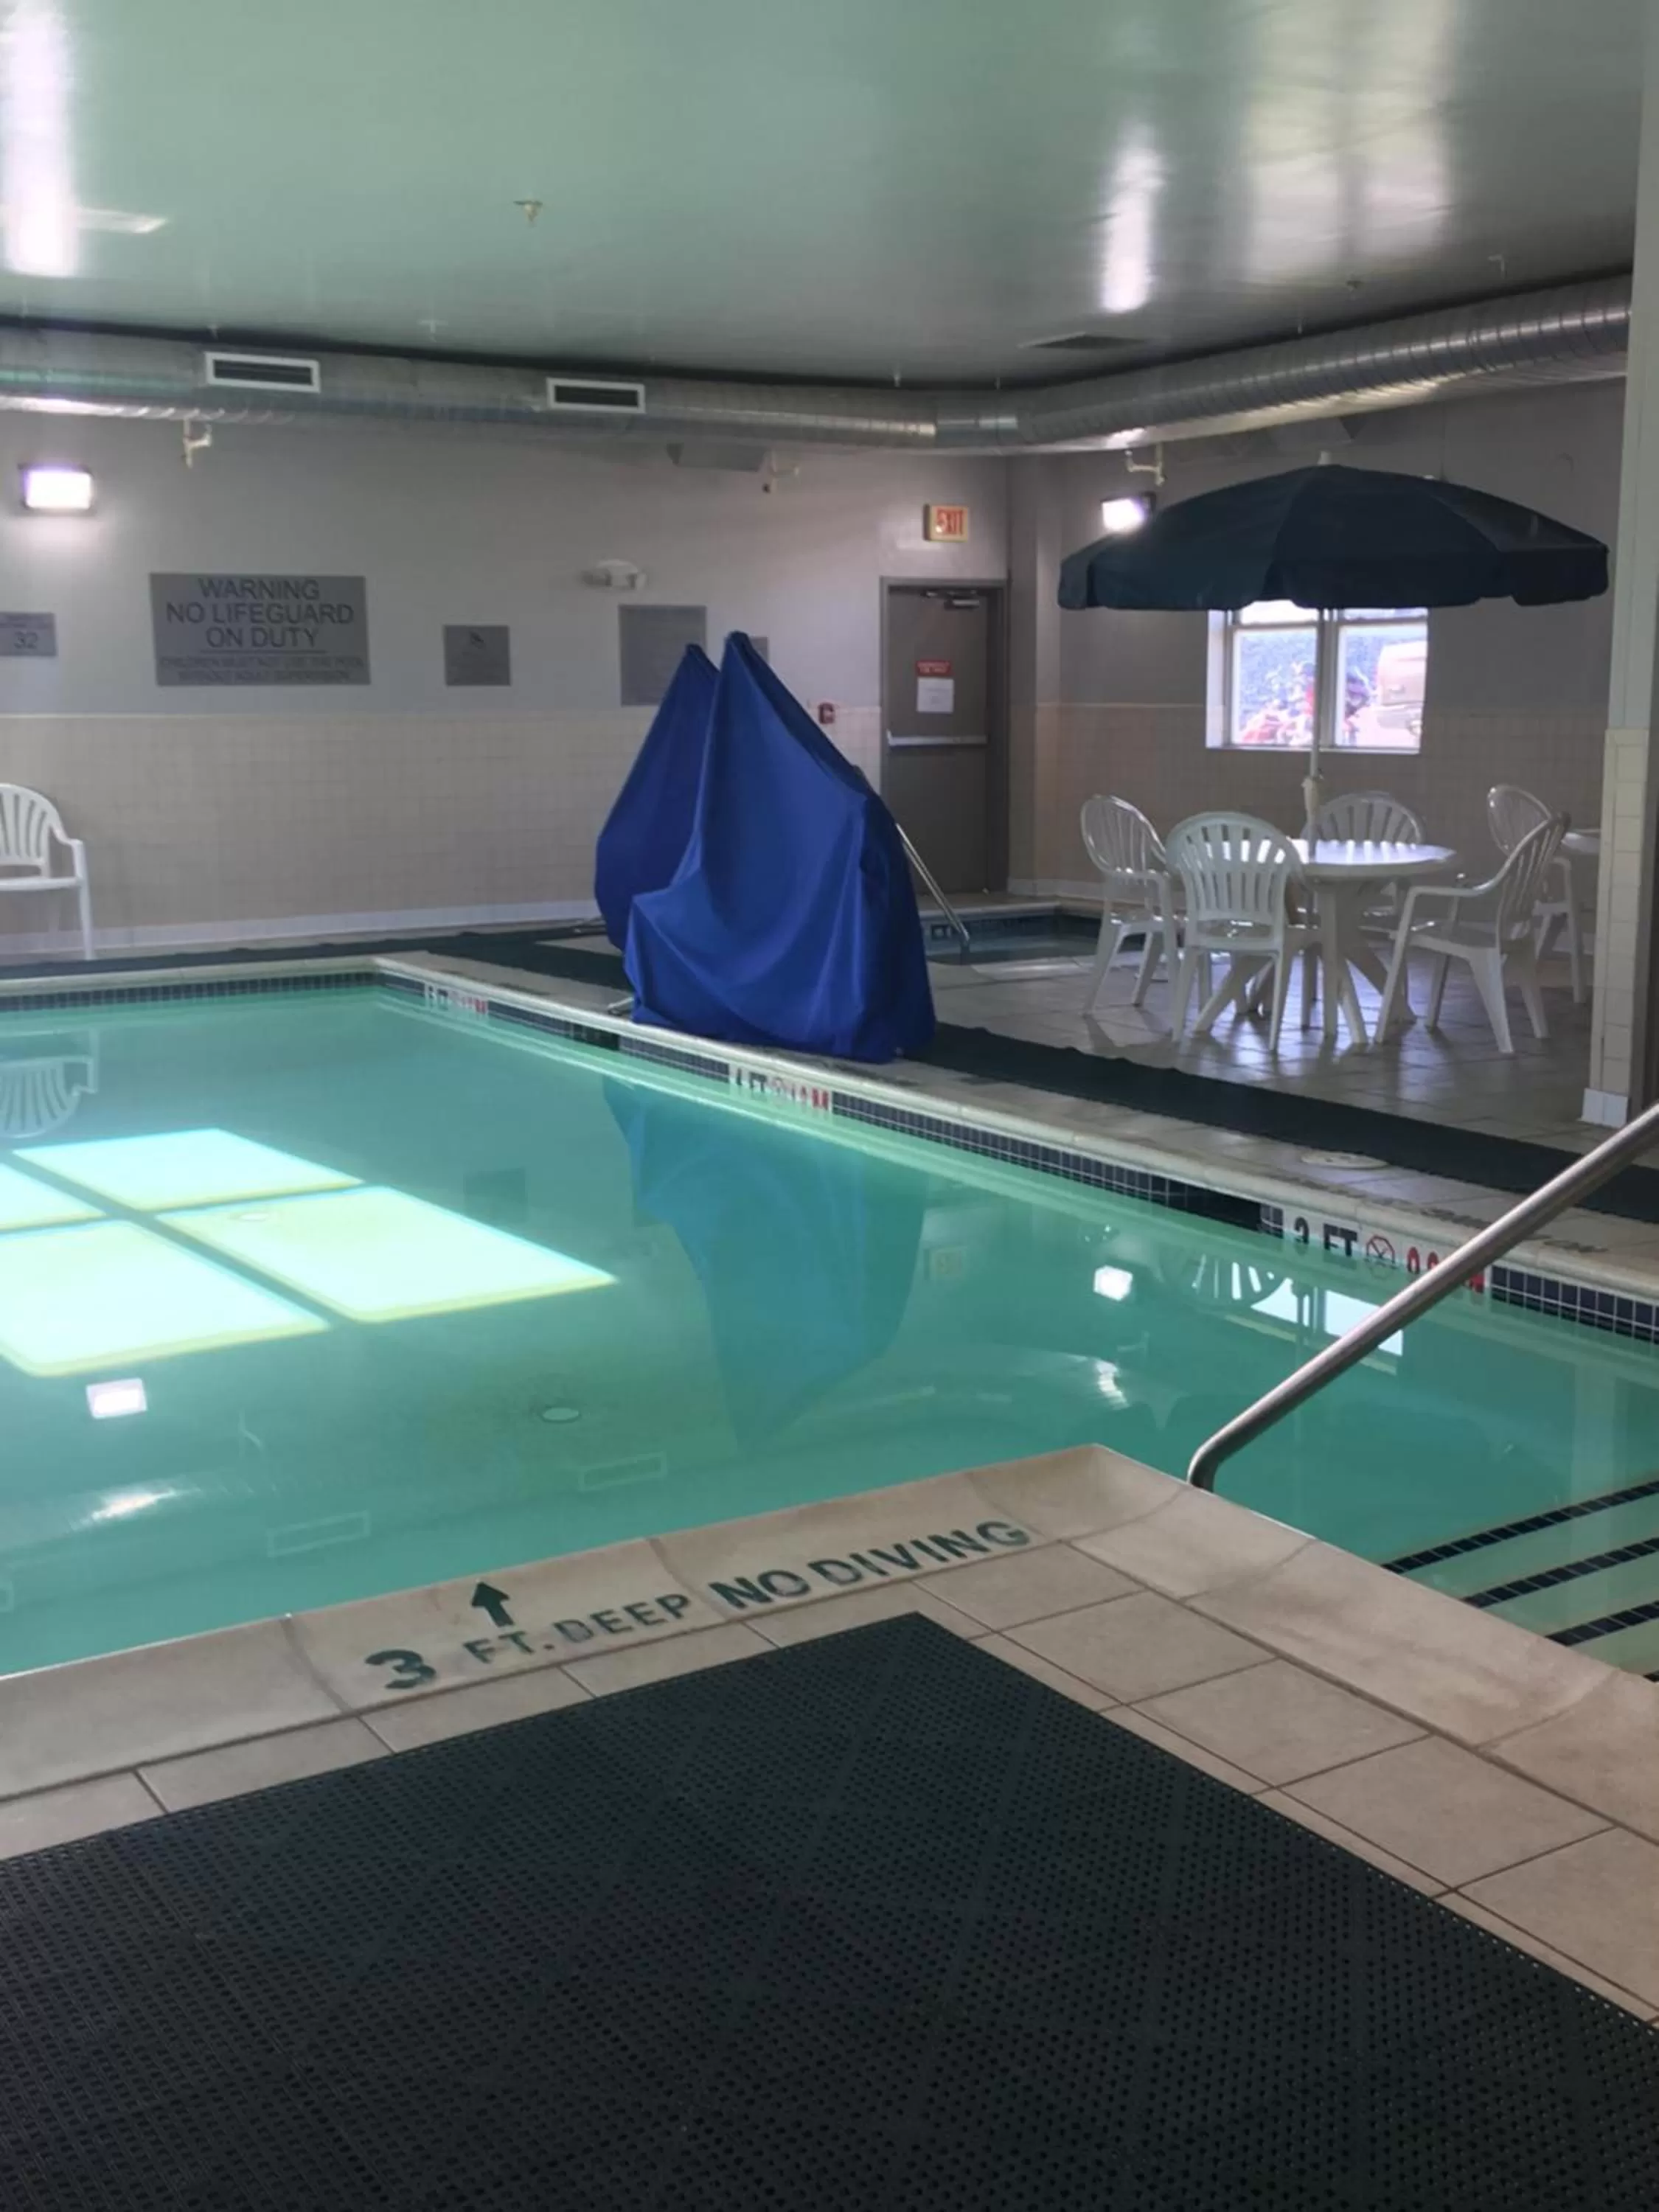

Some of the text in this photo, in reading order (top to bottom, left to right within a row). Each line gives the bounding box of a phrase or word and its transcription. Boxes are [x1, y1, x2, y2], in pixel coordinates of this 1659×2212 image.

[198, 577, 320, 601] WARNING
[166, 601, 355, 625] NO LIFEGUARD
[206, 627, 319, 648] ON DUTY
[1324, 1222, 1358, 1257] FT
[364, 1520, 1031, 1689] 3 FT. DEEP NO DIVING
